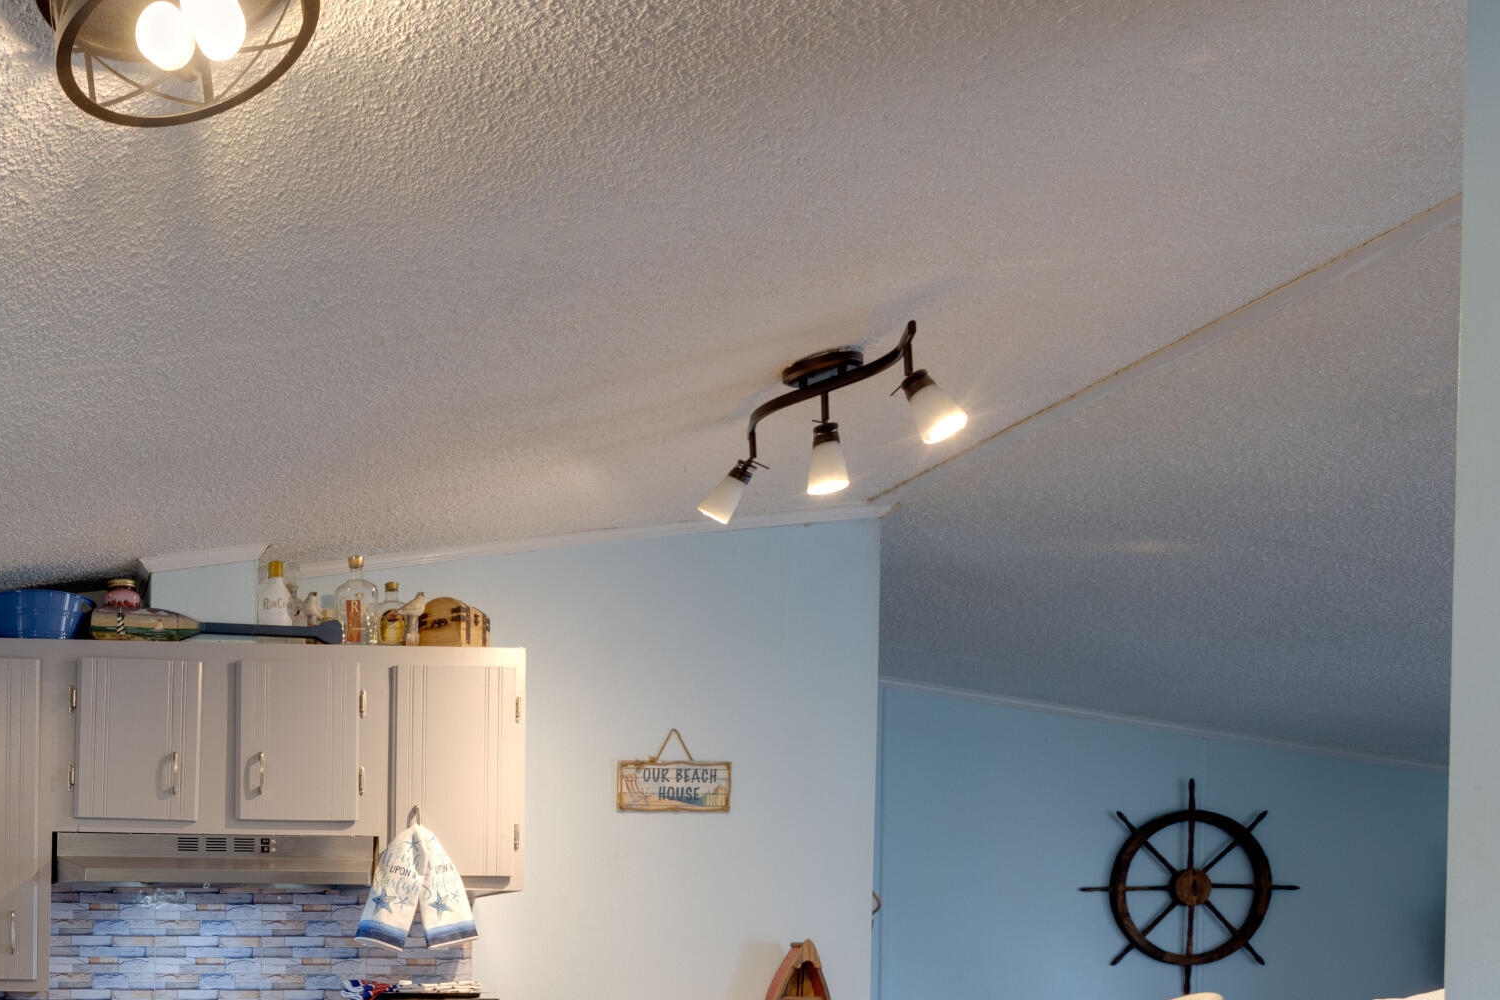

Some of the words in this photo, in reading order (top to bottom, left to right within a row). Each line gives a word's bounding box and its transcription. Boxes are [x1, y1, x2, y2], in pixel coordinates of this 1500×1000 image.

[643, 767, 669, 782] OUR
[675, 768, 717, 783] BEACH
[658, 787, 700, 801] HOUSE
[390, 864, 411, 877] UPON
